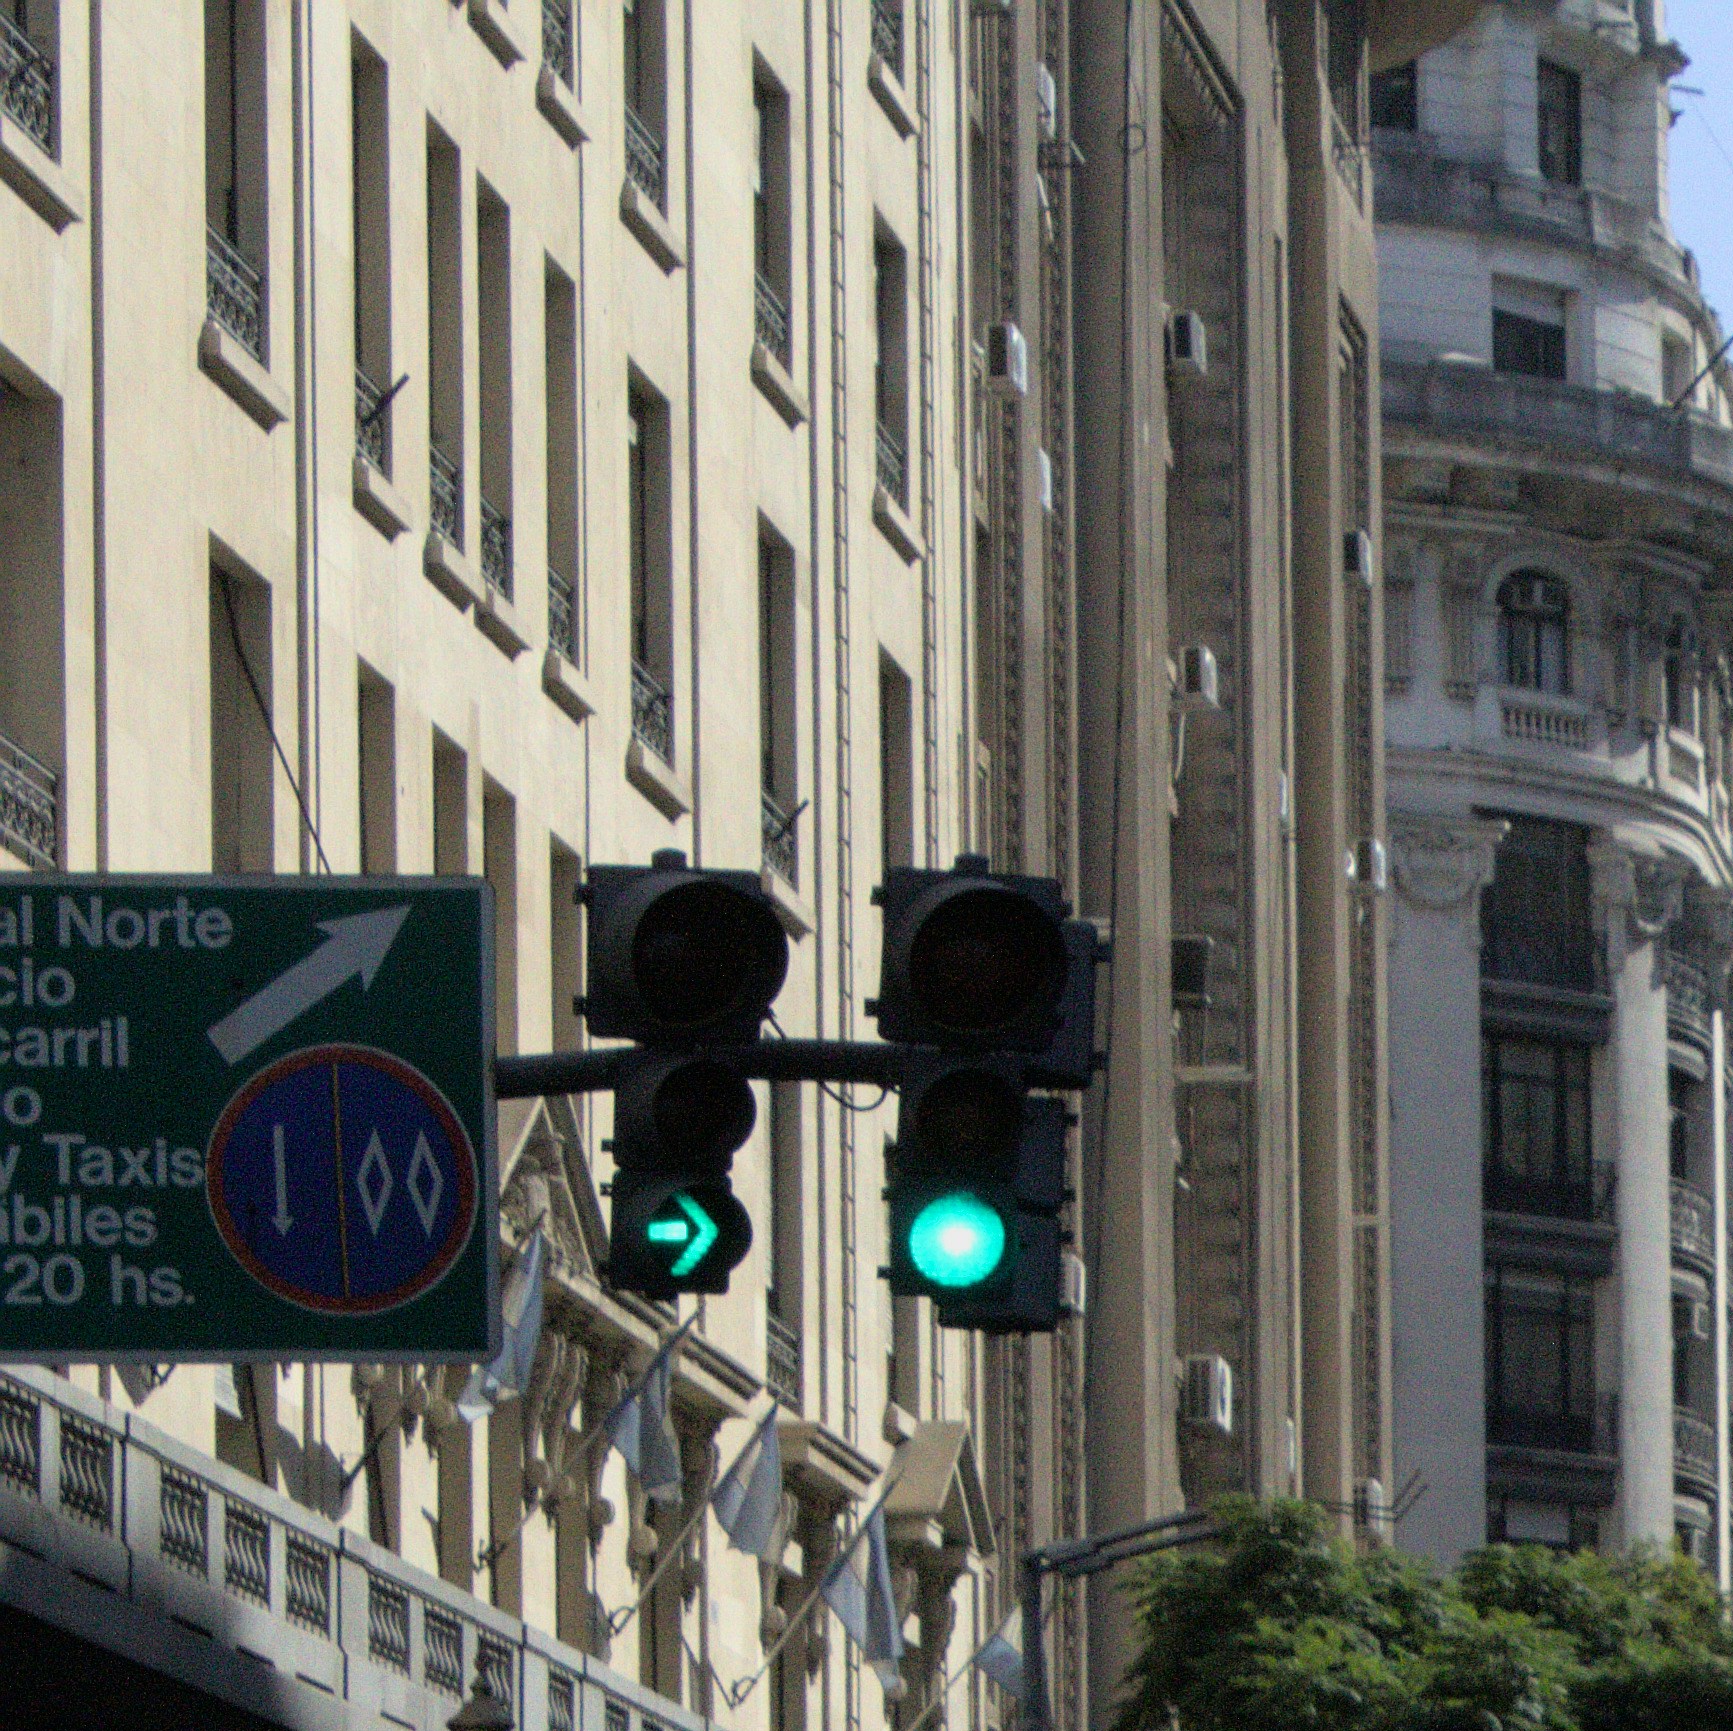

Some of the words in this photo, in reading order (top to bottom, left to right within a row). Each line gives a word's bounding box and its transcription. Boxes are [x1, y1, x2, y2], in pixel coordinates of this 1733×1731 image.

[58, 897, 233, 949] Norte
[44, 1134, 206, 1188] Taxis
[0, 1194, 158, 1248] biles
[2, 1254, 86, 1304] 20
[111, 1254, 196, 1307] hs.
